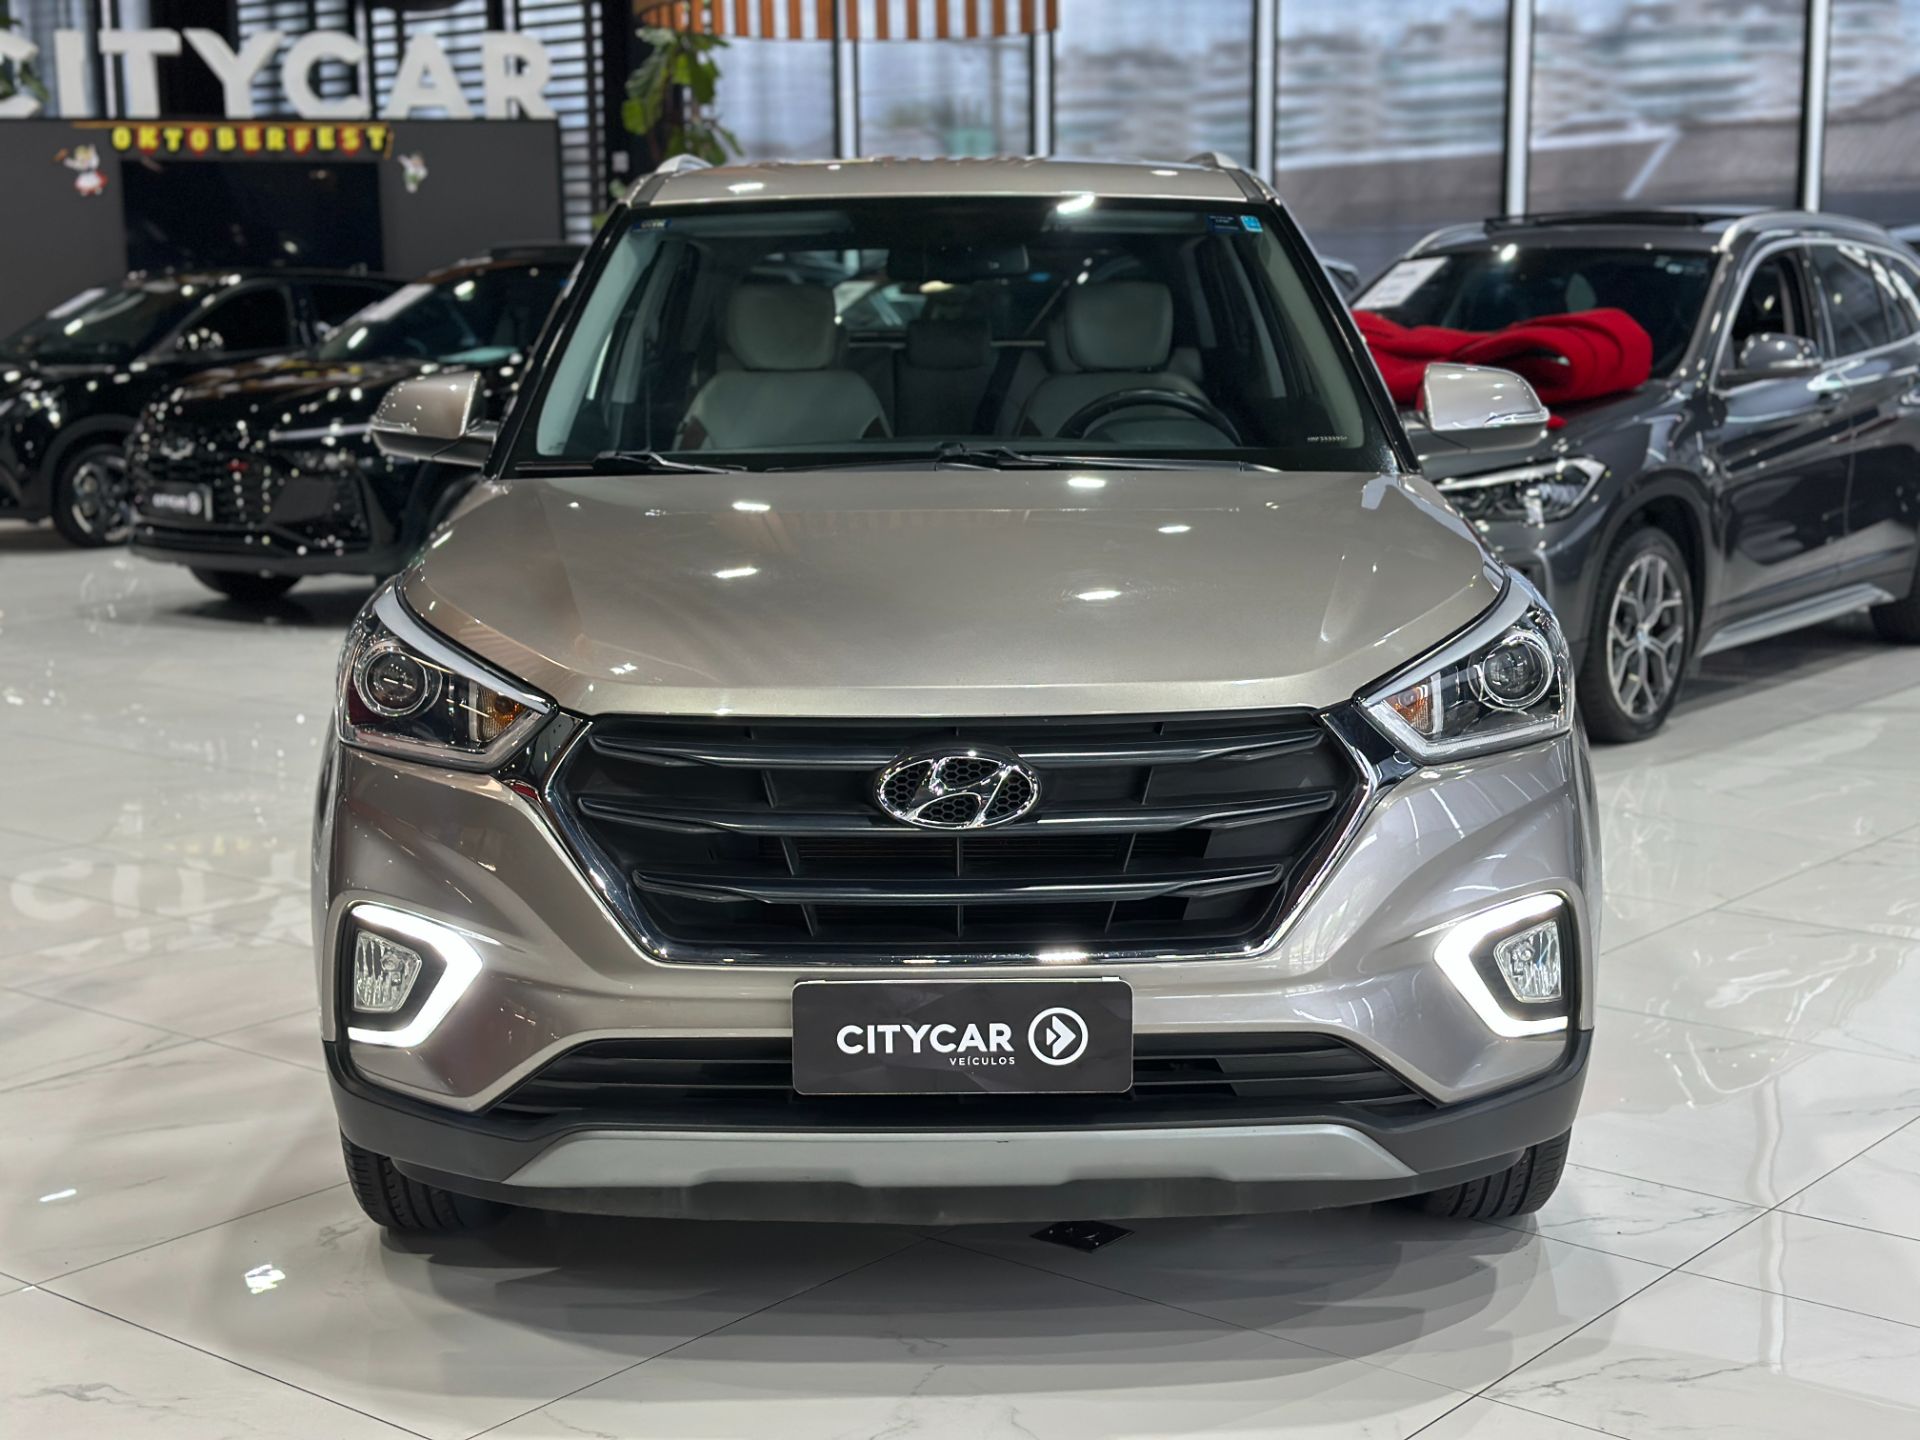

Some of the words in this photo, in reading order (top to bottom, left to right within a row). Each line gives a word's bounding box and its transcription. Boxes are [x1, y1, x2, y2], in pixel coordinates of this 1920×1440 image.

[112, 126, 386, 151] OKTOBERFEST
[836, 1023, 1015, 1055] CITYCAR
[949, 1055, 1016, 1066] VEÍCULOS
